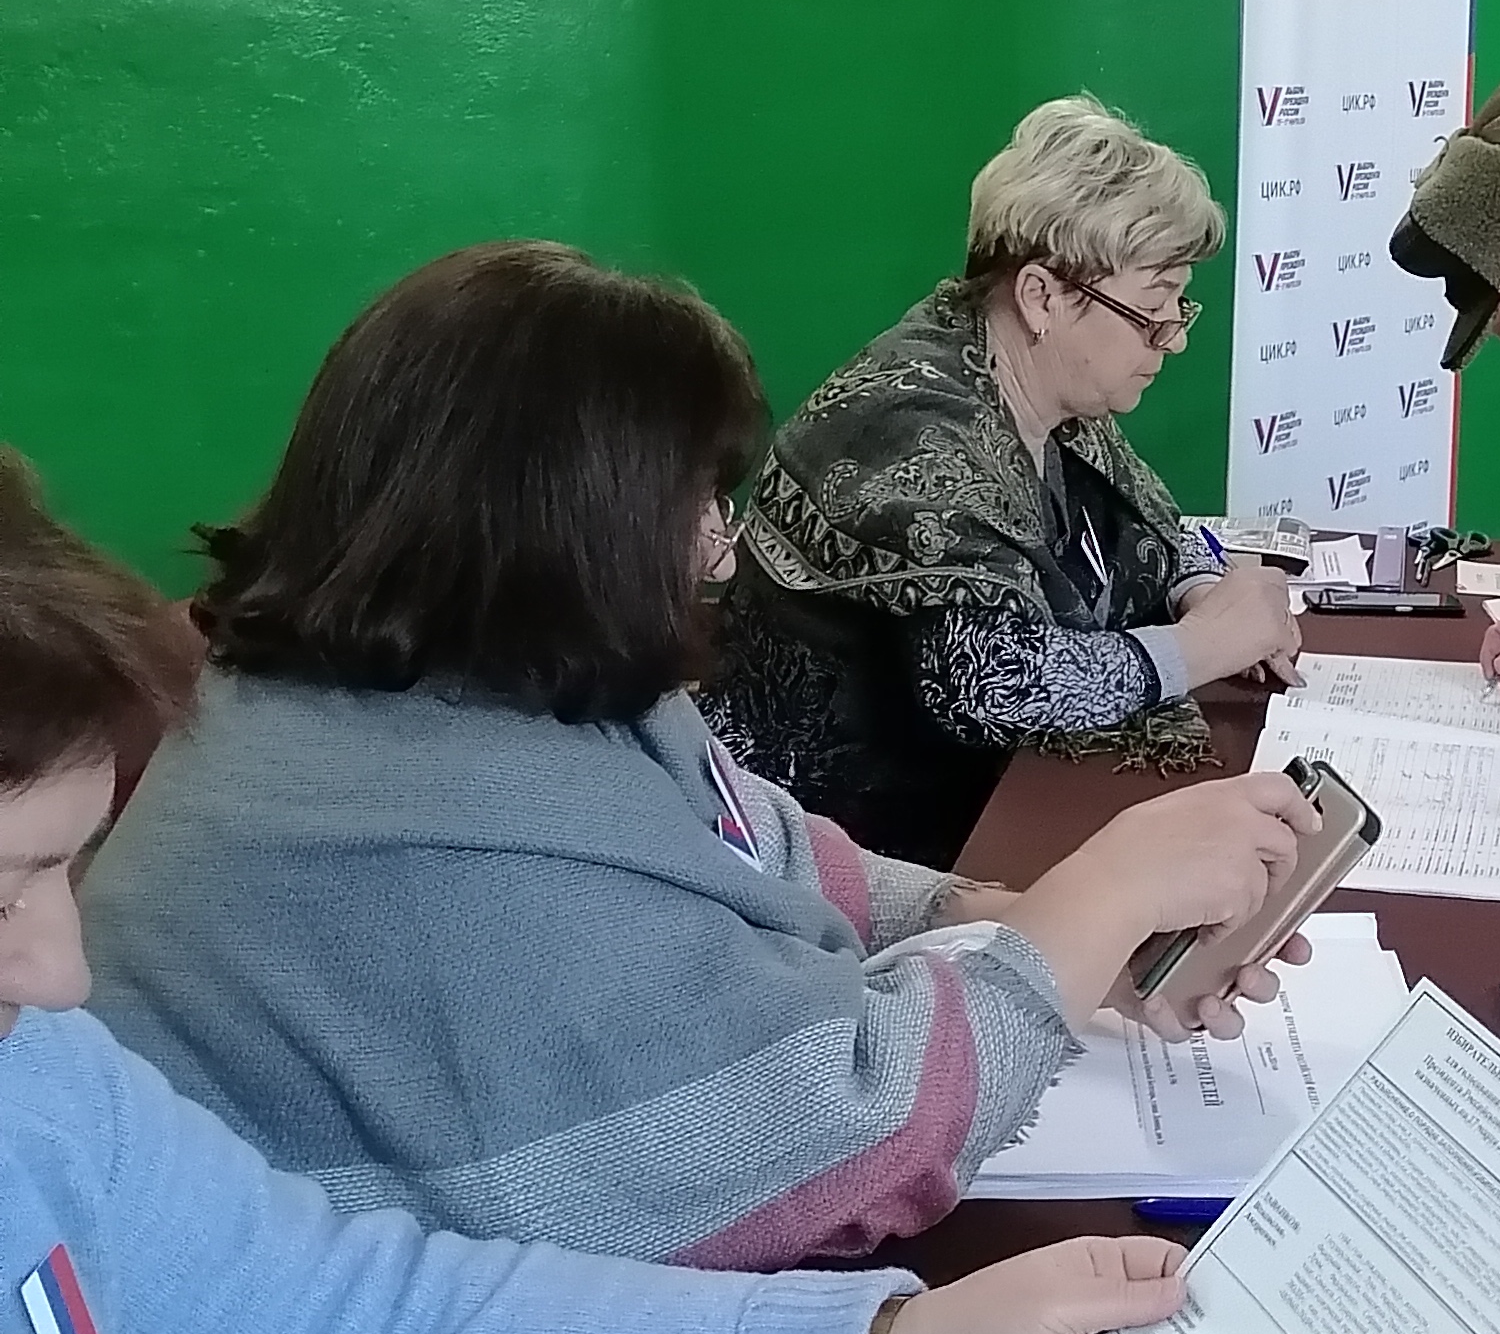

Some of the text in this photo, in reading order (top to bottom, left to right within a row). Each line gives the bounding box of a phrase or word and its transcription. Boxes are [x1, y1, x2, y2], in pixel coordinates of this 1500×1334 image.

[1342, 94, 1377, 114] ЦИК.РФ
[1261, 180, 1302, 202] ЦИК.РФ
[1338, 252, 1372, 273] ЦИК.РФ
[1404, 314, 1435, 335] ЦИК.РФ
[1260, 340, 1297, 364] ЦИК.РФ
[1333, 403, 1367, 427] ЦИК.РФ
[1399, 460, 1430, 483] ЦИК.РФ
